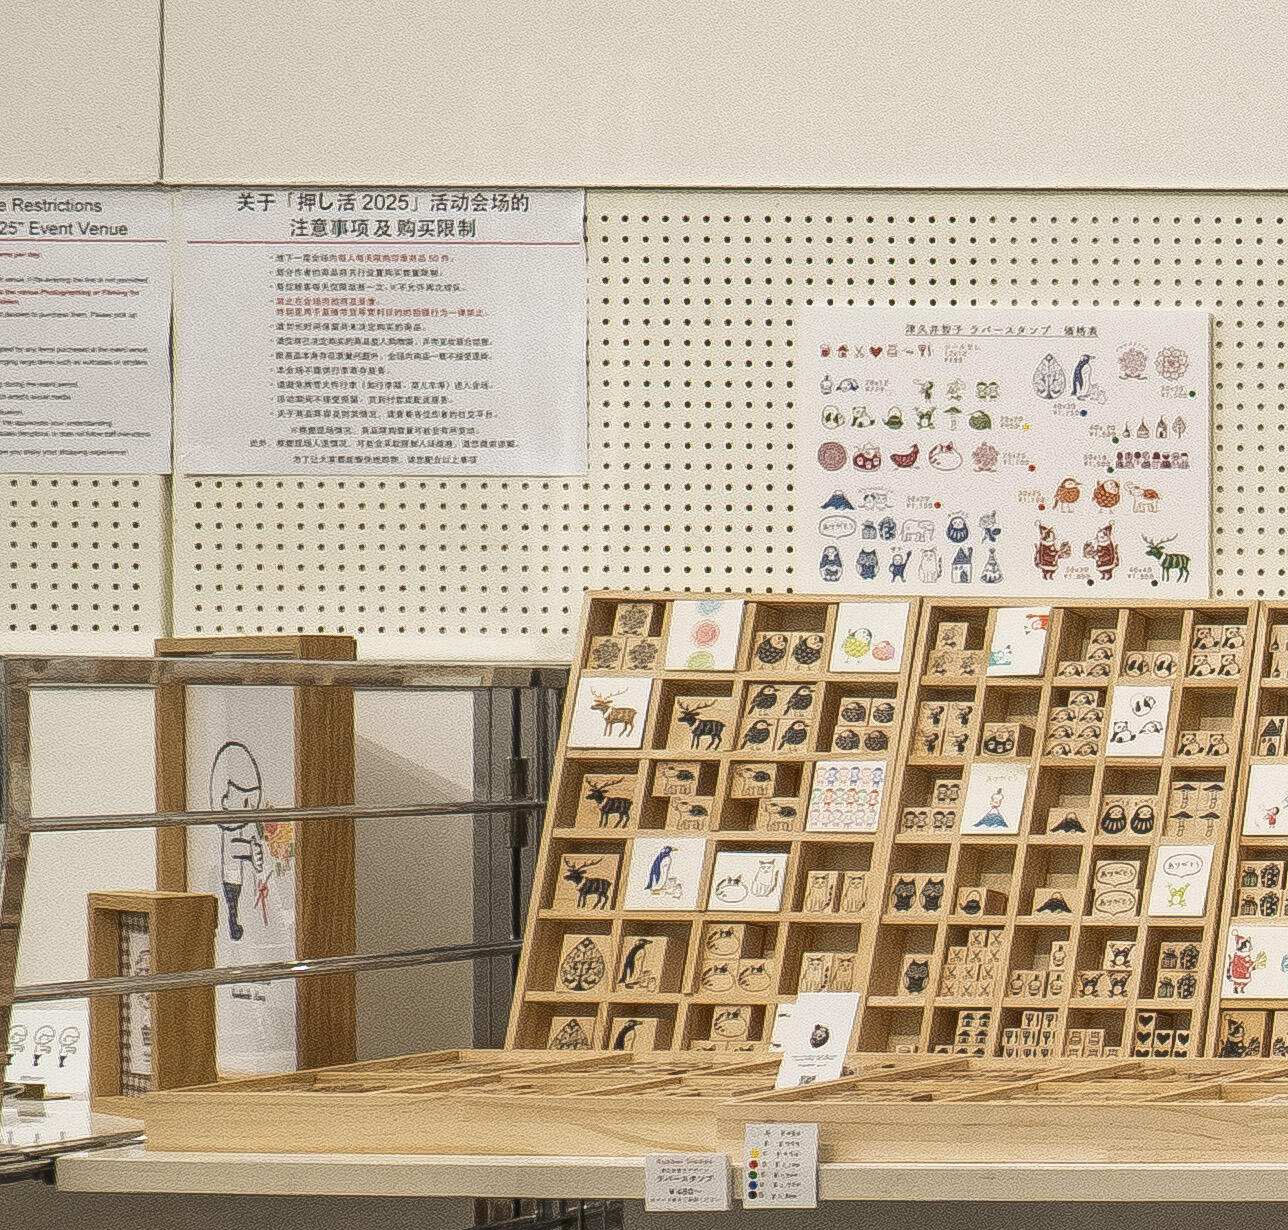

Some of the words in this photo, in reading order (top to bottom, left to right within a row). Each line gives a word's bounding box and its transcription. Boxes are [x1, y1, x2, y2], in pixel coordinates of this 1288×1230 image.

[12, 197, 102, 213] Restrictions
[29, 221, 73, 235] Event
[78, 221, 128, 235] Venue
